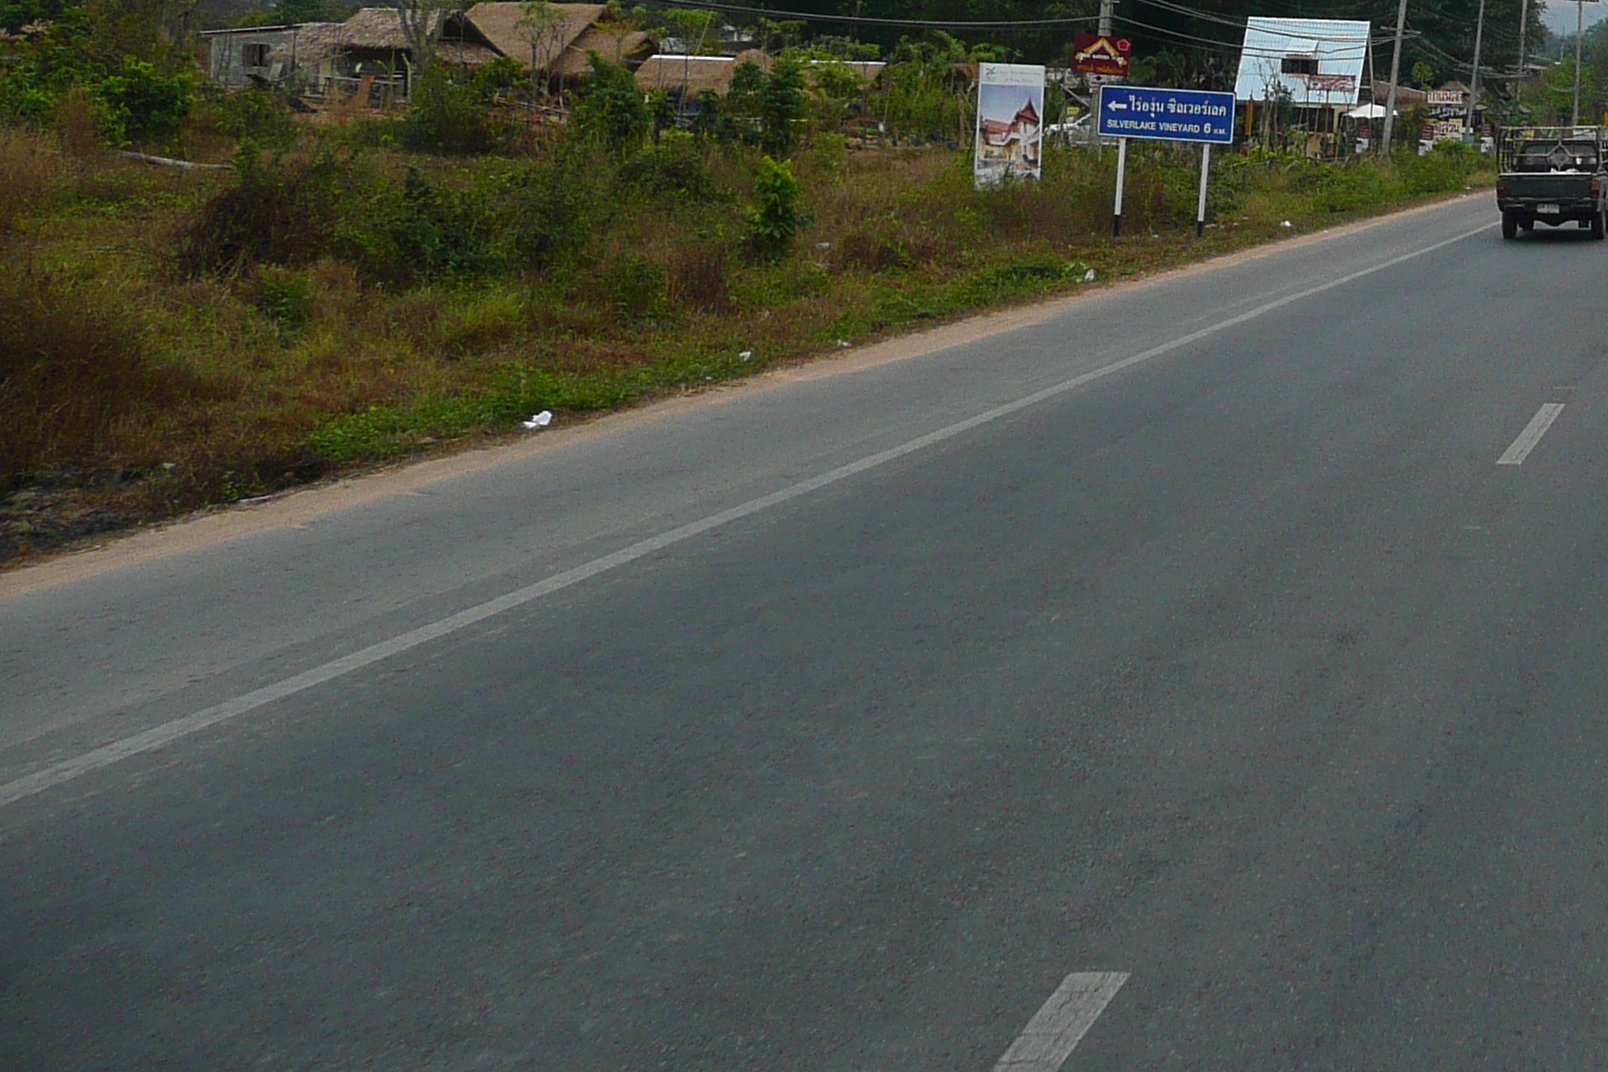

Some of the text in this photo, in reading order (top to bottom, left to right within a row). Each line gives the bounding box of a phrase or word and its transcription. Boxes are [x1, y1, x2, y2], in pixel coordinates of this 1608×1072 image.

[1129, 94, 1226, 118] ไร่องุ่น ซิลเวอร์เลค
[1107, 119, 1156, 132] SILVERLAKE
[1159, 123, 1200, 134] VINEYARD
[1203, 123, 1211, 134] 6
